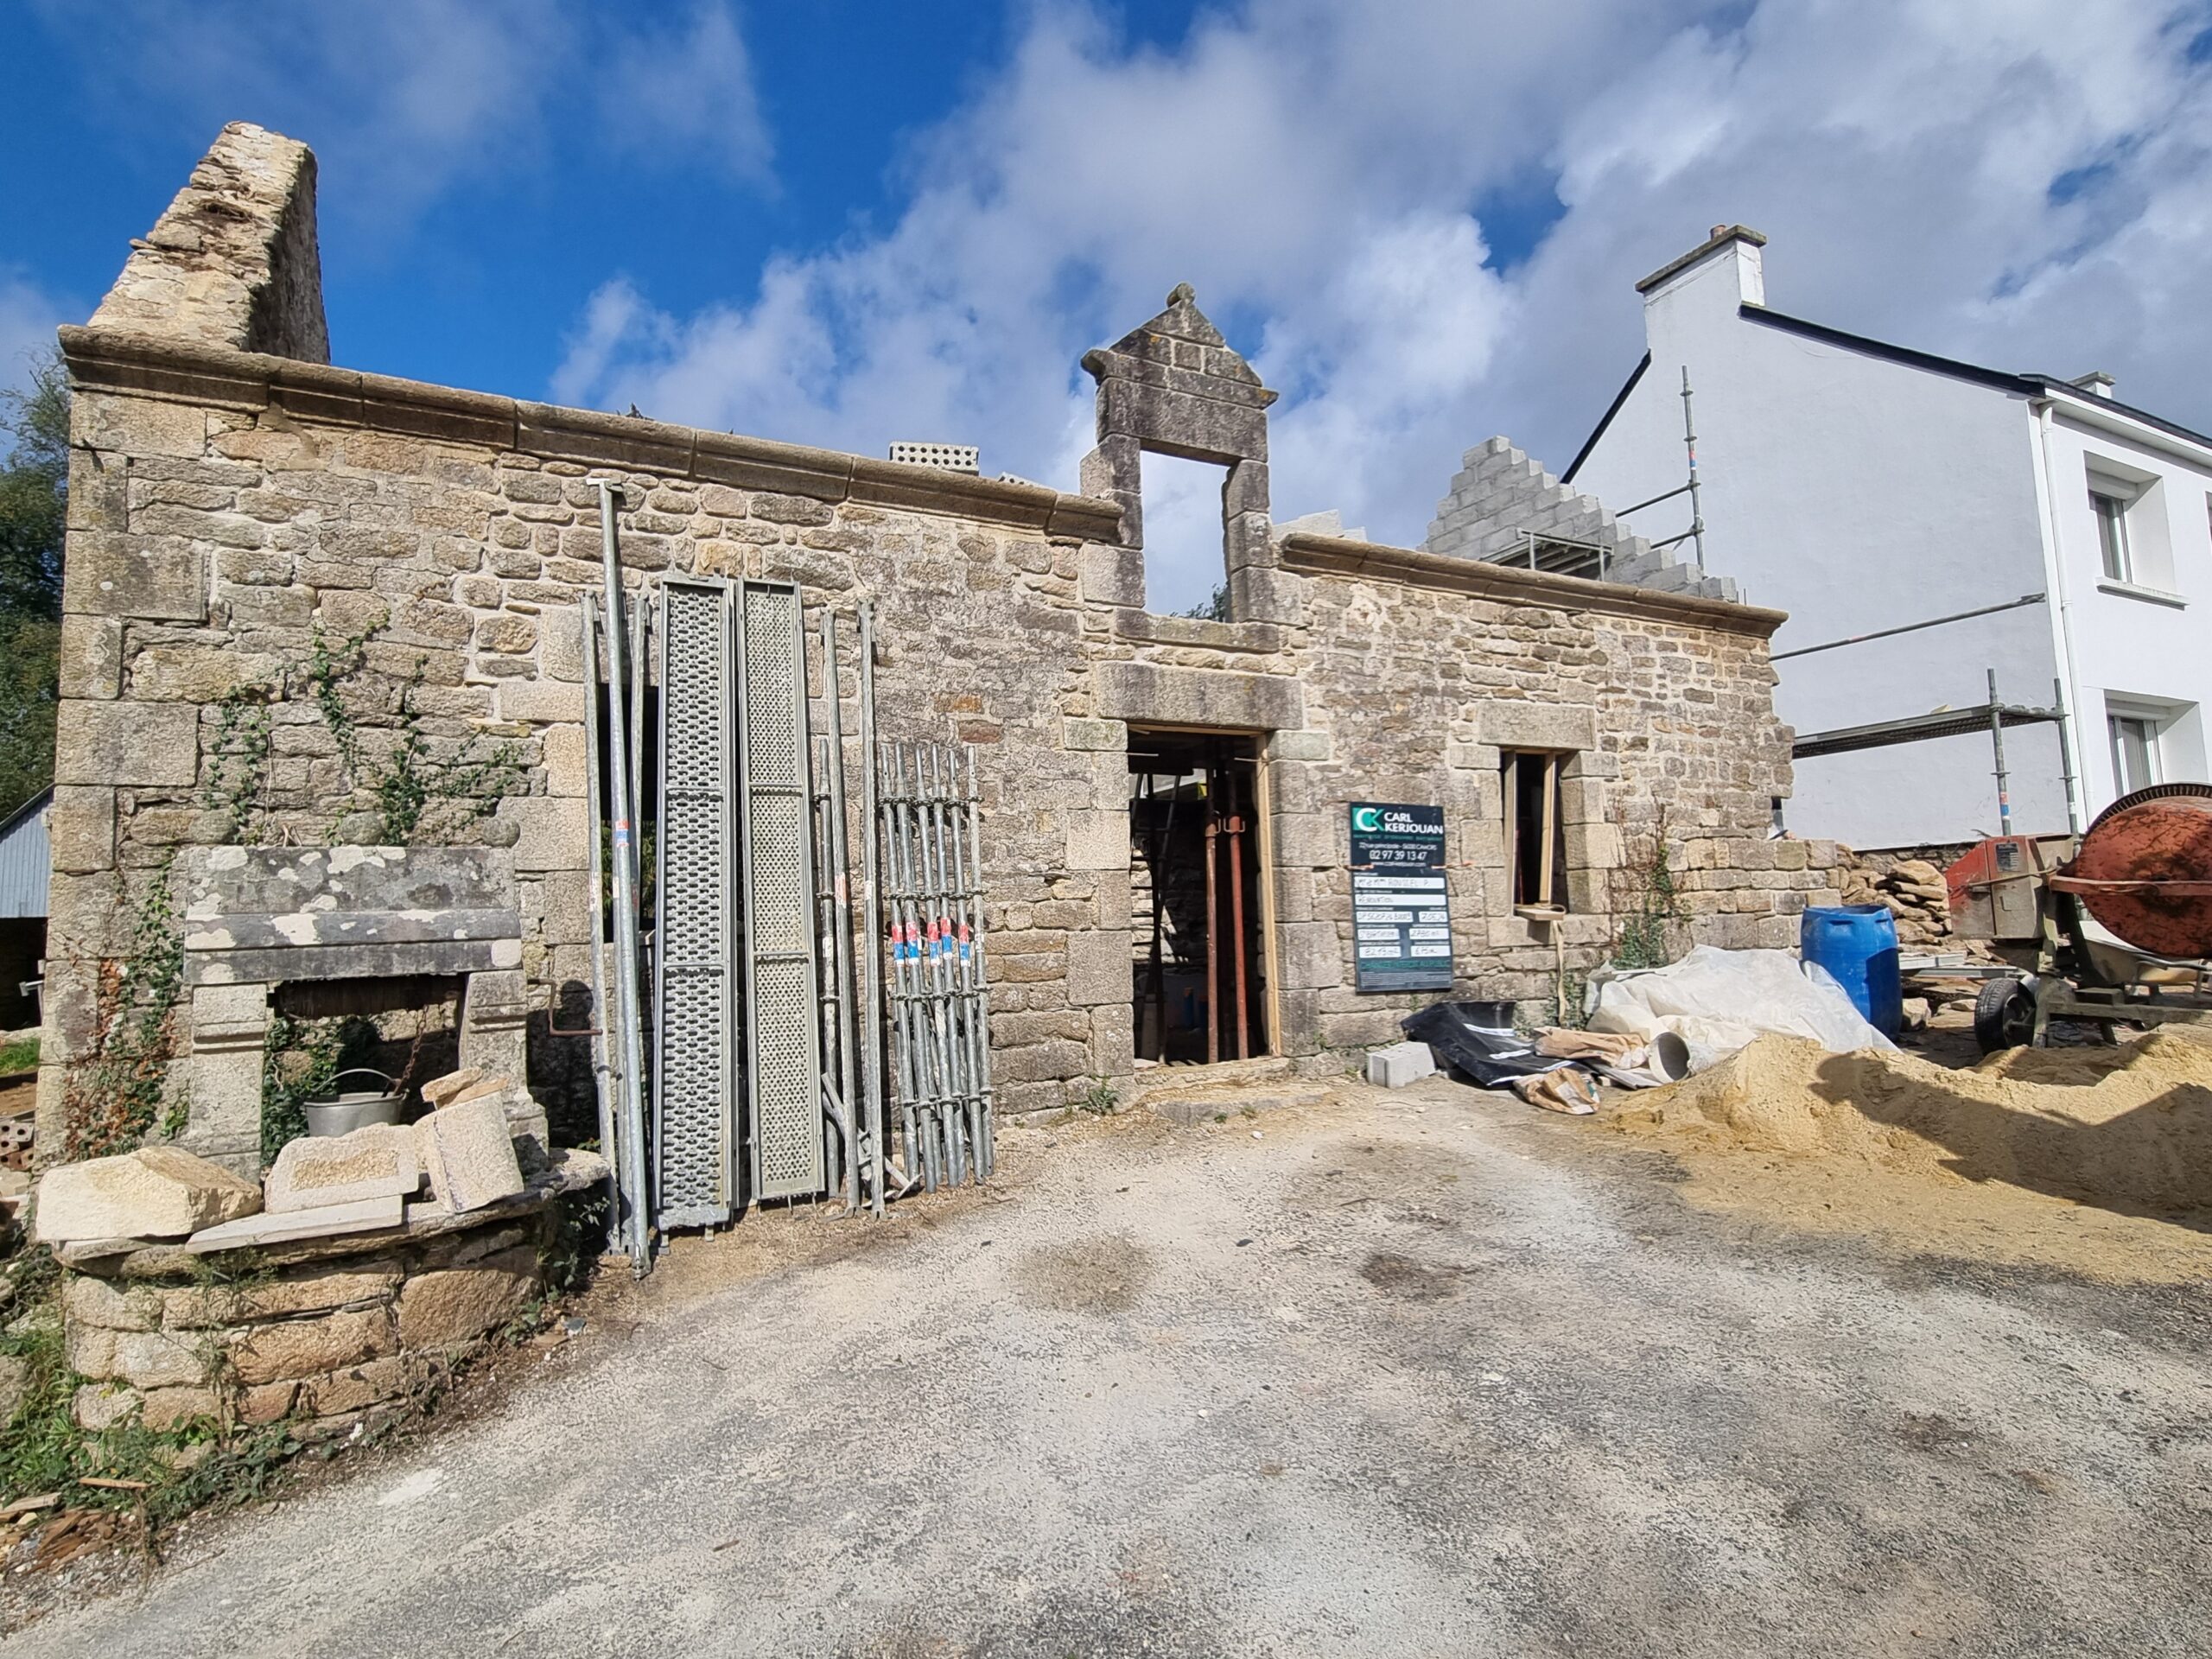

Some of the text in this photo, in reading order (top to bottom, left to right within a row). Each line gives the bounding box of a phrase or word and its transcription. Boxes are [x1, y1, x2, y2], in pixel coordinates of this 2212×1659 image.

[1384, 812, 1413, 823] CARL
[1384, 823, 1443, 834] KERJOUAN
[1369, 850, 1427, 861] 02 97 39 13 47
